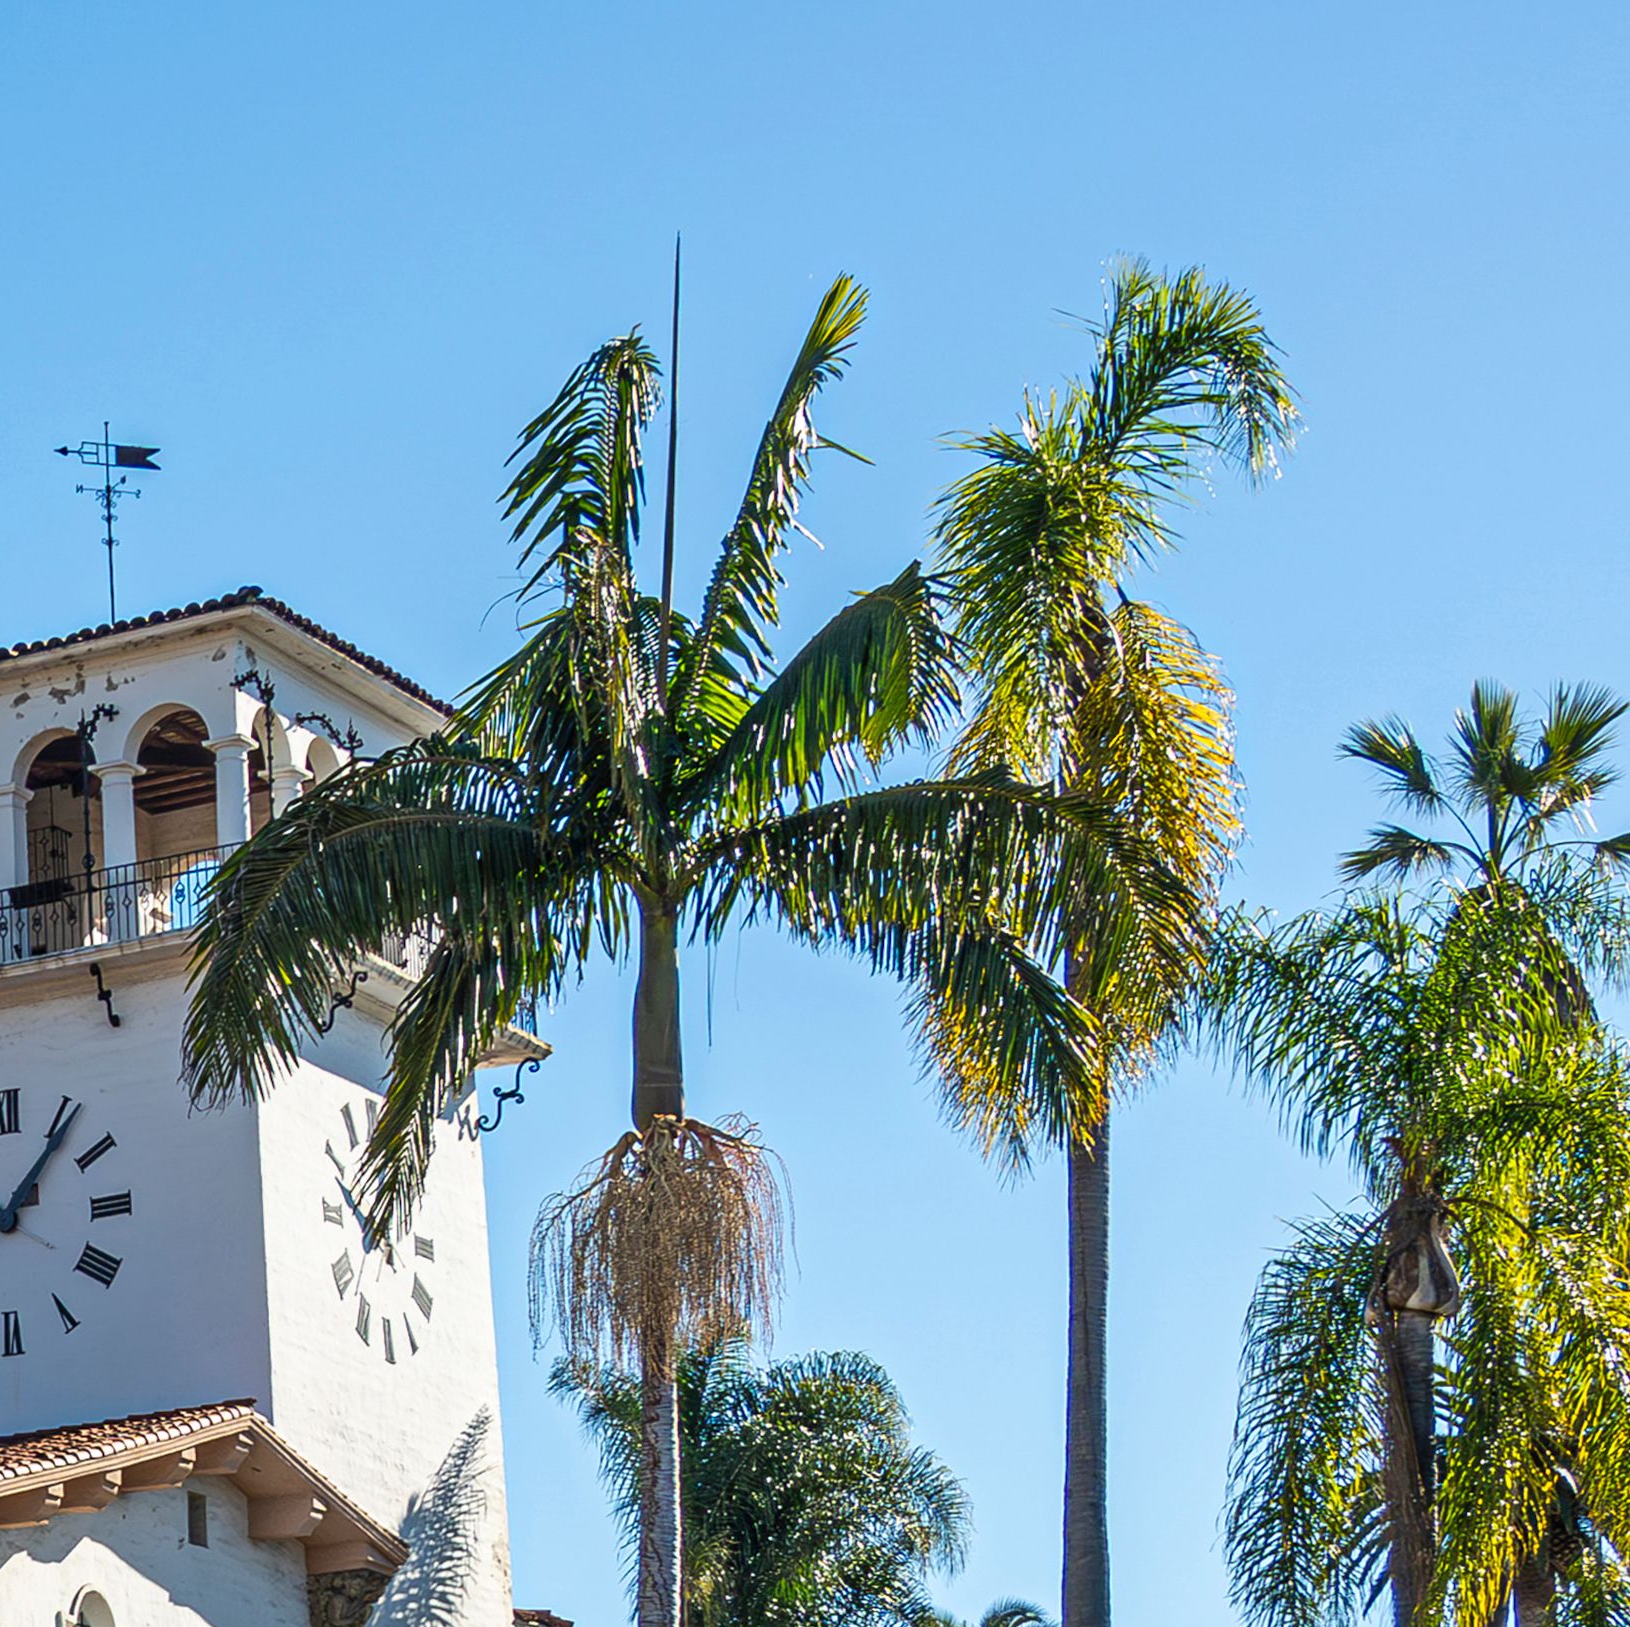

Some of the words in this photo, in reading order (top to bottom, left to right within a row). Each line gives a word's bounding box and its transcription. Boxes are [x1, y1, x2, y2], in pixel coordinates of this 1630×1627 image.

[74, 1131, 117, 1174] II
[90, 1189, 132, 1222] III
[1, 1311, 26, 1357] VI
[52, 1292, 81, 1335] V
